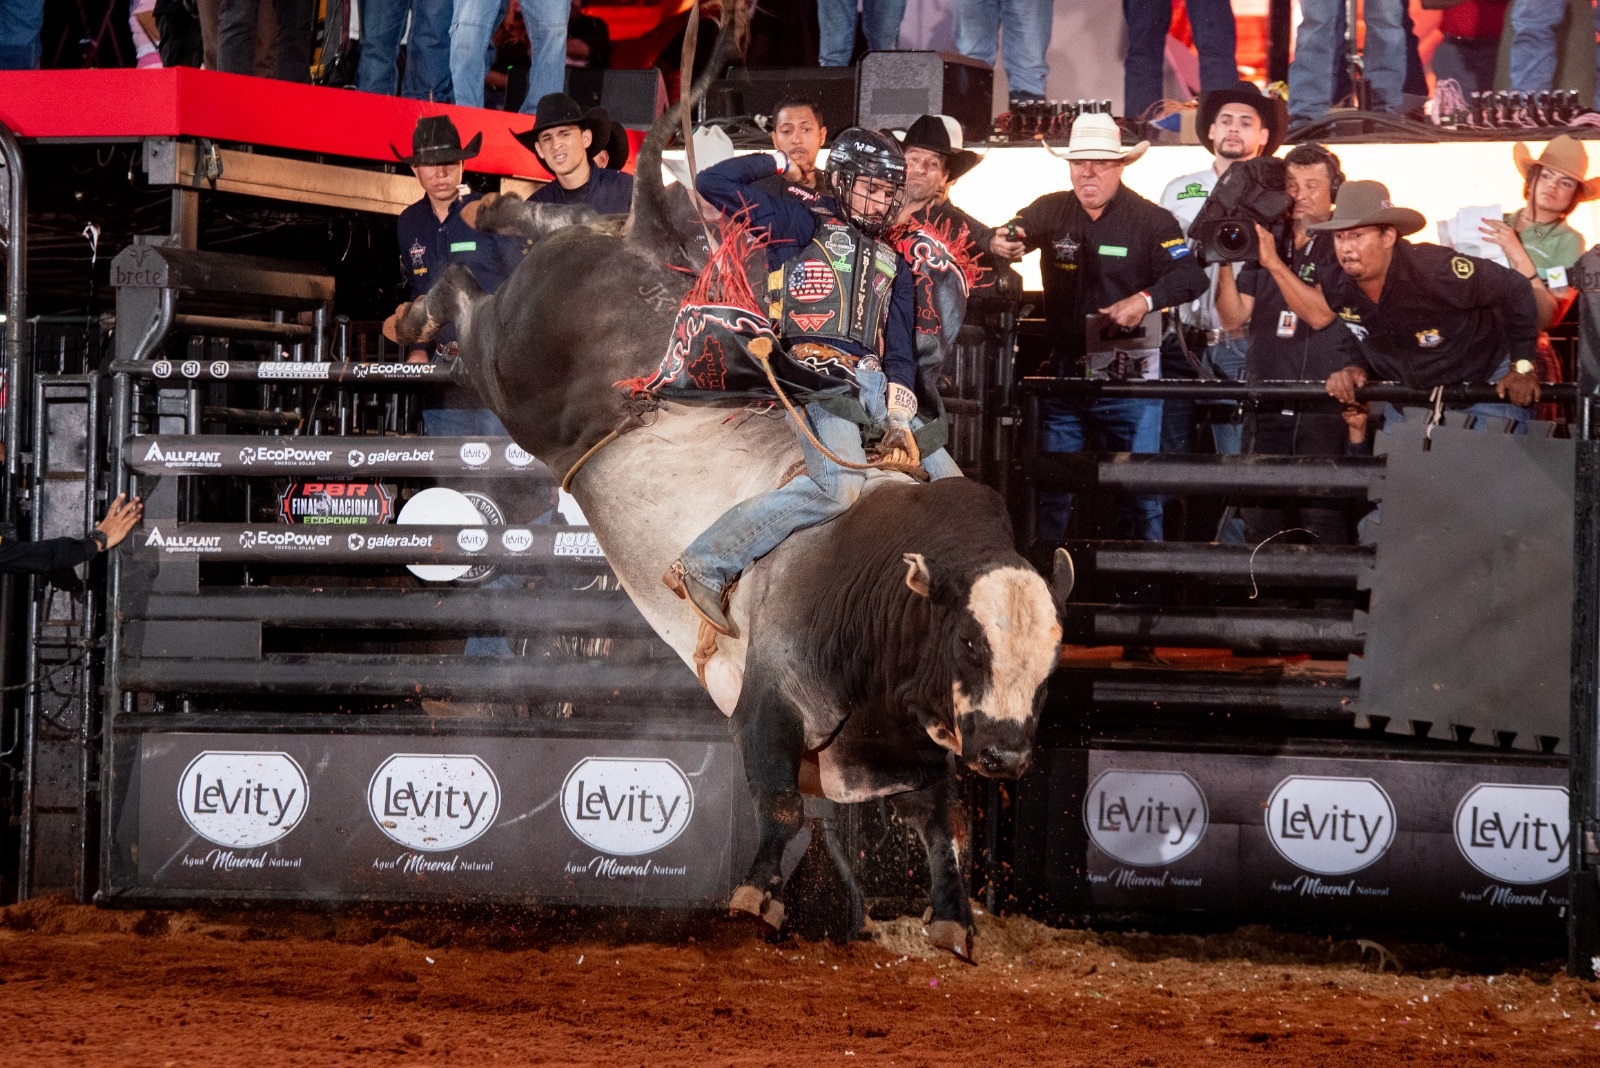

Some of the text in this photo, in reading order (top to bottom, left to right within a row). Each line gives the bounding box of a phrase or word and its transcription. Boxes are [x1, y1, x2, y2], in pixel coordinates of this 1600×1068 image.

[116, 265, 162, 285] brete
[795, 269, 829, 283] BILL
[794, 284, 829, 295] WAY
[369, 363, 437, 374] EcoPower
[165, 451, 221, 462] ALLPLANT
[258, 447, 333, 461] EcoPower
[367, 449, 434, 465] galera.bet
[302, 483, 369, 496] PBR
[292, 498, 380, 516] FINAL NACIONAL
[303, 516, 368, 524] ECOPOWER
[165, 536, 221, 547] ALLPLANT
[258, 531, 332, 545] EcoPower
[367, 534, 433, 549] galera.bet
[205, 849, 267, 870] Mineral
[268, 857, 302, 868] Natural
[395, 853, 456, 874] Mineral
[460, 860, 494, 871] Natural
[588, 856, 652, 879] Mineral
[652, 865, 686, 875] Natural
[1293, 875, 1356, 898] Mineral
